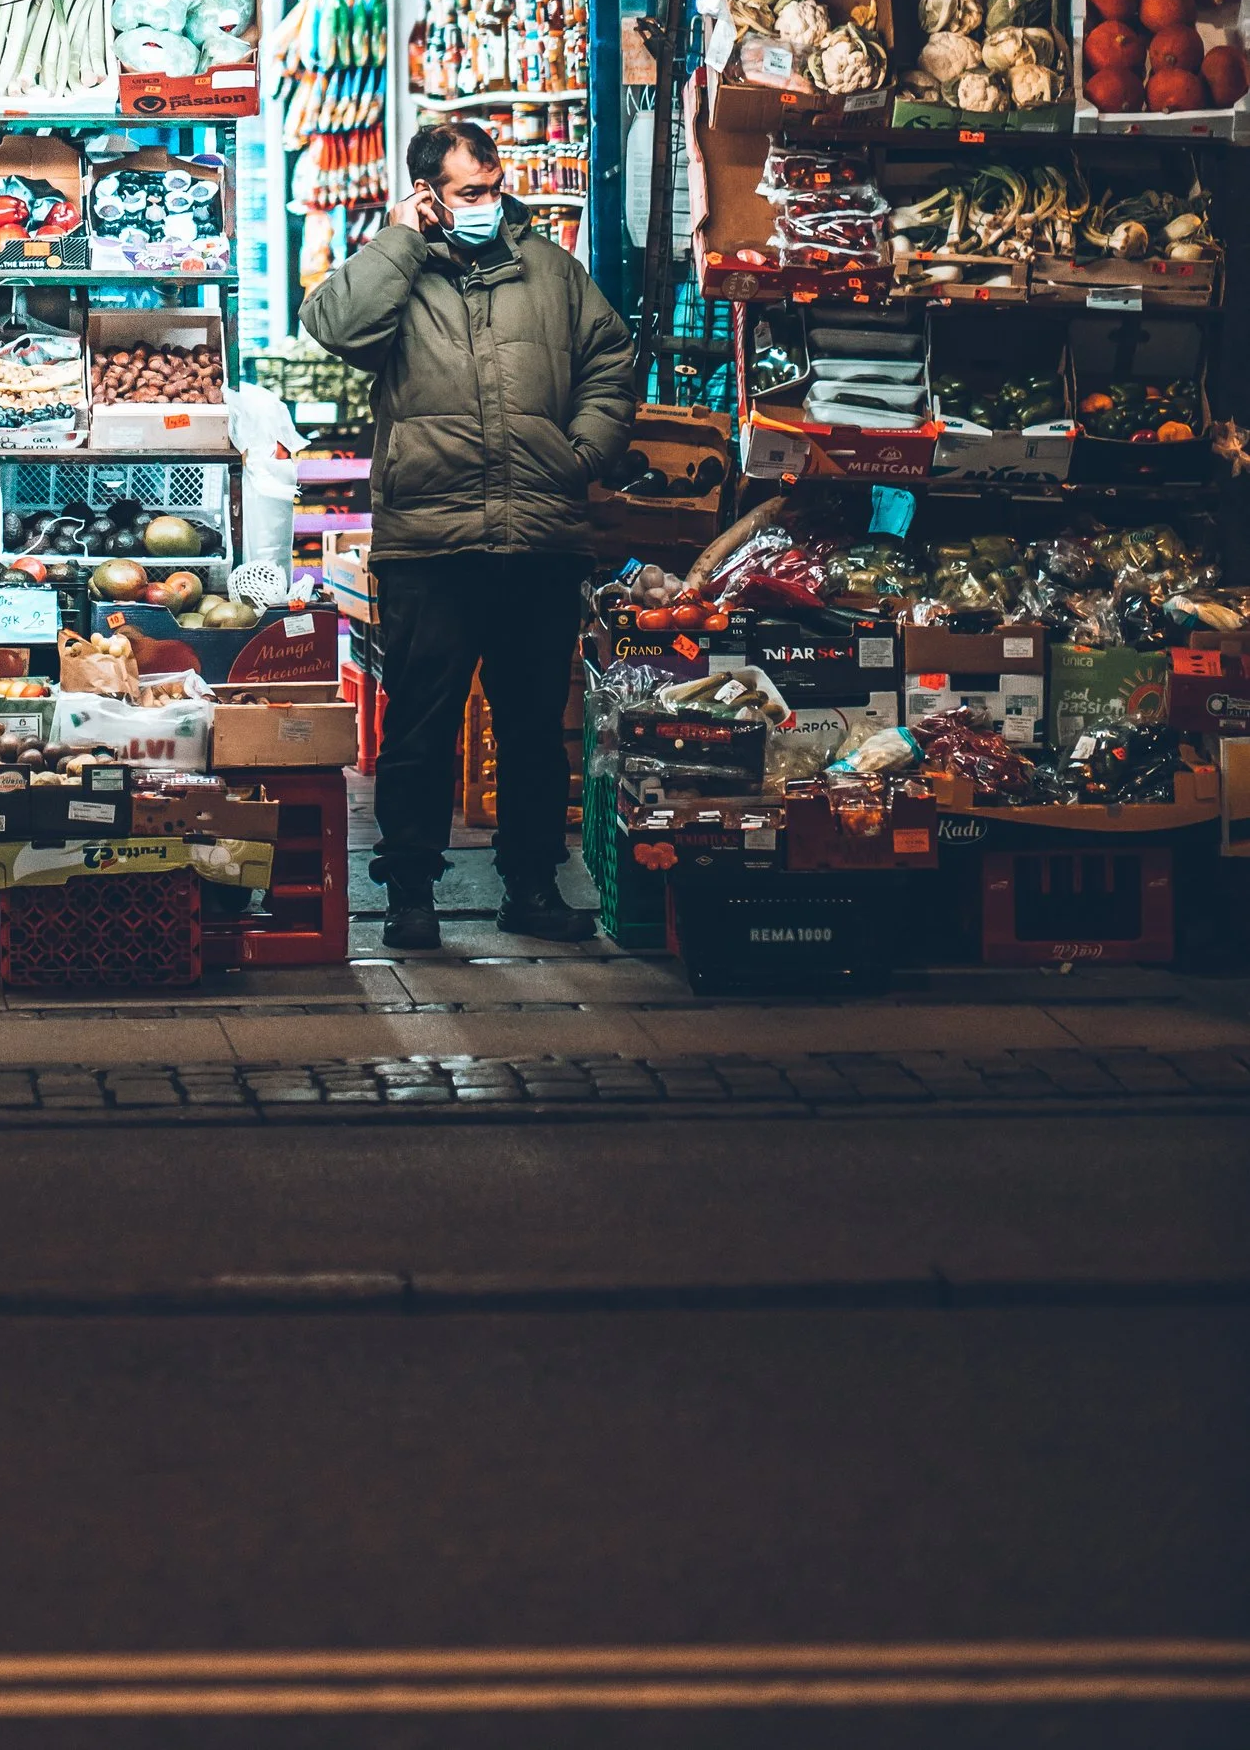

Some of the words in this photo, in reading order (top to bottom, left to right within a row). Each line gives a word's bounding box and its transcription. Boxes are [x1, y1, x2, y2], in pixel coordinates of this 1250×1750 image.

[169, 93, 247, 111] passion
[847, 460, 924, 476] MERTCAN
[253, 640, 314, 667] Manga
[615, 637, 663, 661] GRAND
[1062, 654, 1094, 667] unica
[245, 659, 331, 684] Selecionada
[1057, 698, 1126, 717] passion
[750, 927, 795, 942] REMA
[797, 927, 833, 942] 1000
